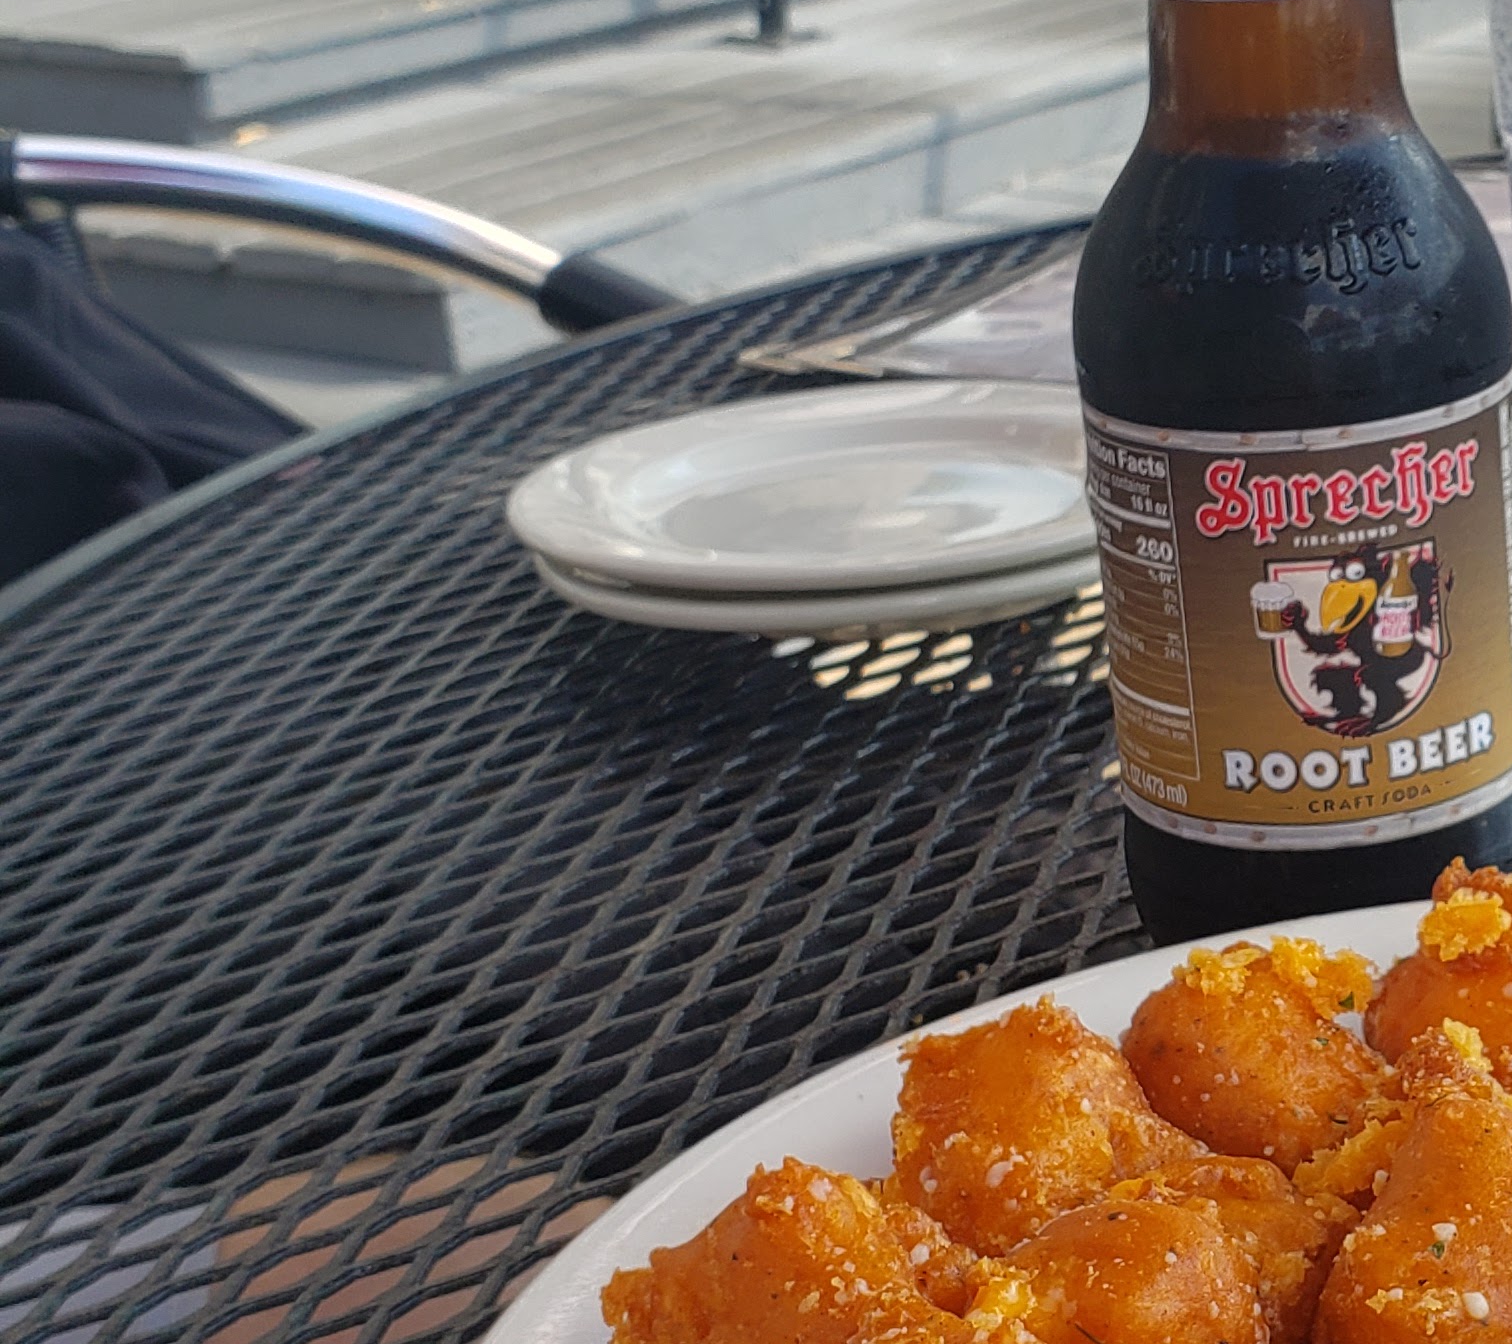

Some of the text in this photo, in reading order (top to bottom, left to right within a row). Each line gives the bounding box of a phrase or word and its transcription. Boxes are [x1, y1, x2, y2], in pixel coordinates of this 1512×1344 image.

[1118, 448, 1166, 479] Facts
[1196, 439, 1479, 546] Sprecher
[1222, 711, 1496, 794] ROOT BEER
[1308, 783, 1433, 815] CRAFT SODA
